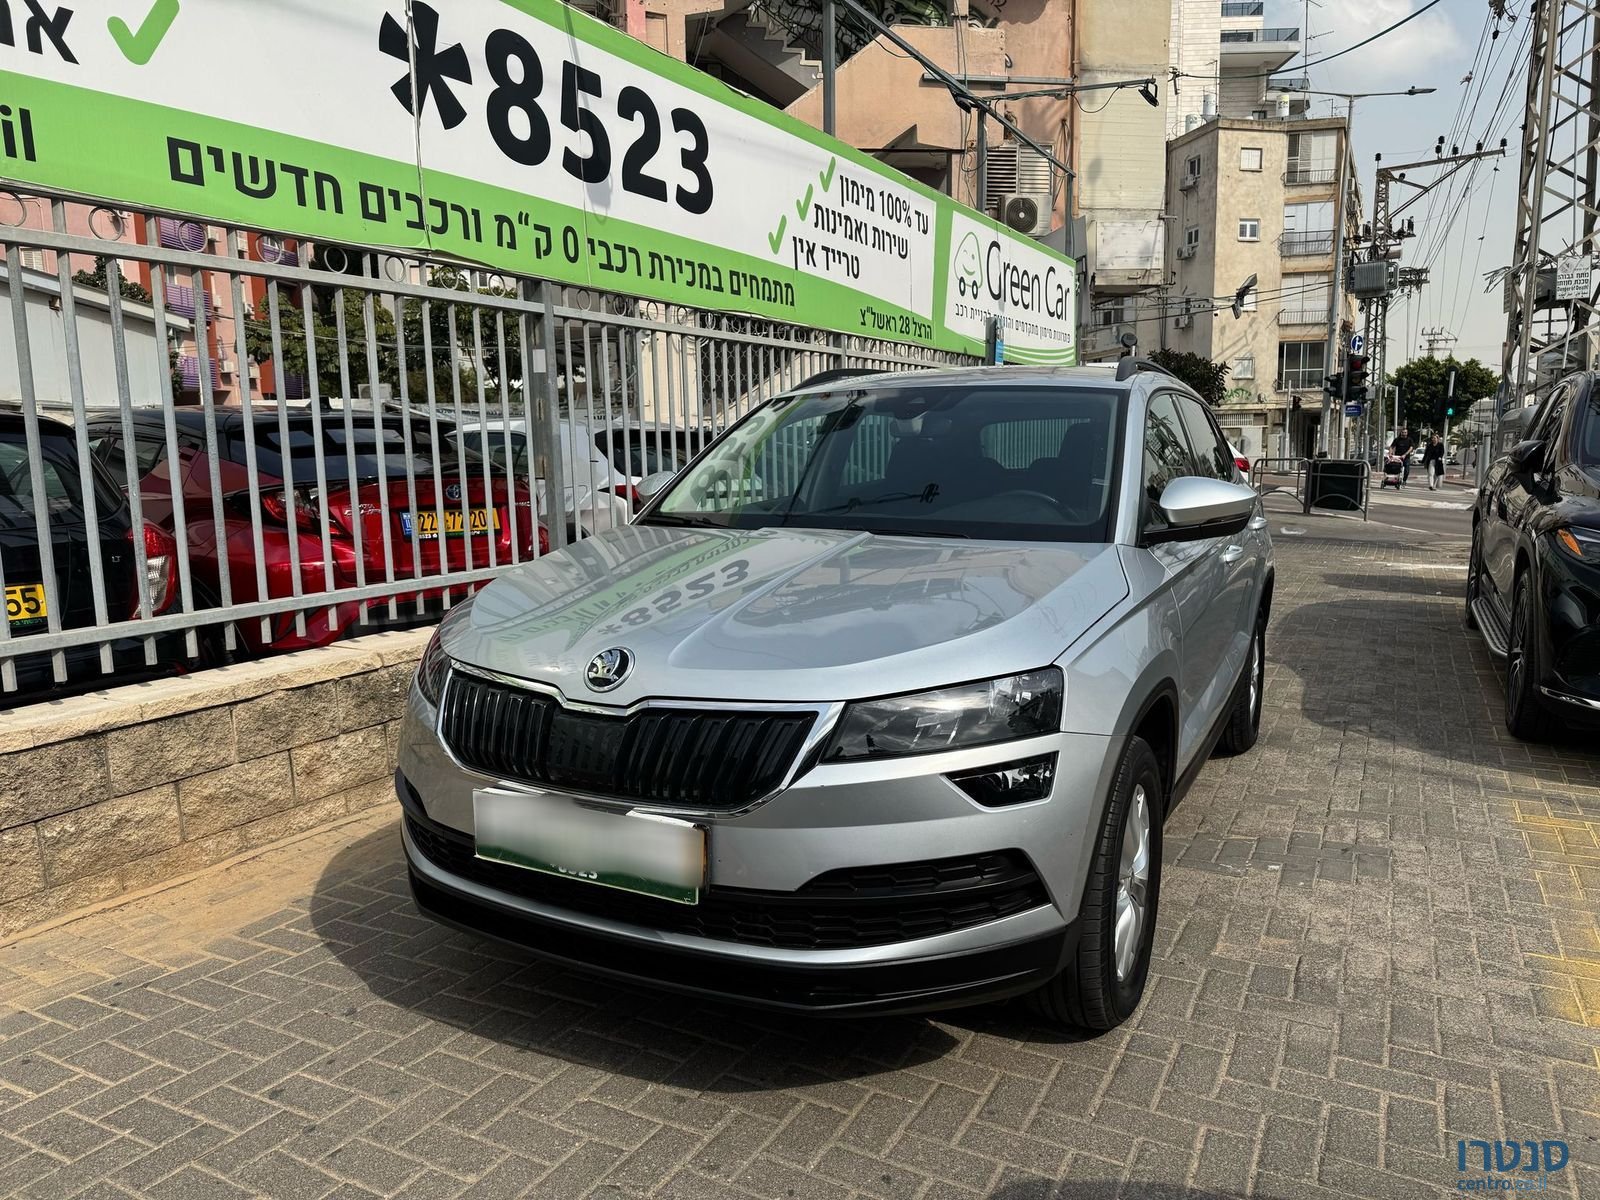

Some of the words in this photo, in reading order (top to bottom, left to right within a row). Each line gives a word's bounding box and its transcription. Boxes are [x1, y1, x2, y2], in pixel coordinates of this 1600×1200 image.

[166, 136, 344, 215] חדשים
[840, 174, 875, 212] מימון
[359, 181, 482, 243] ורכבים
[814, 203, 868, 246] ואמינות
[879, 190, 912, 228] 100%
[914, 209, 929, 235] עד
[562, 225, 579, 264] 0
[587, 237, 642, 277] רכבי
[793, 235, 817, 271] אין
[821, 245, 860, 279] טרייד
[872, 226, 908, 260] שירות
[649, 251, 724, 293] במכירת
[729, 270, 795, 307] מתמחים
[986, 240, 1041, 313] Green
[1045, 266, 1070, 321] Car
[899, 314, 911, 335] 28
[912, 316, 932, 340] הרצל
[955, 303, 968, 318] רכב
